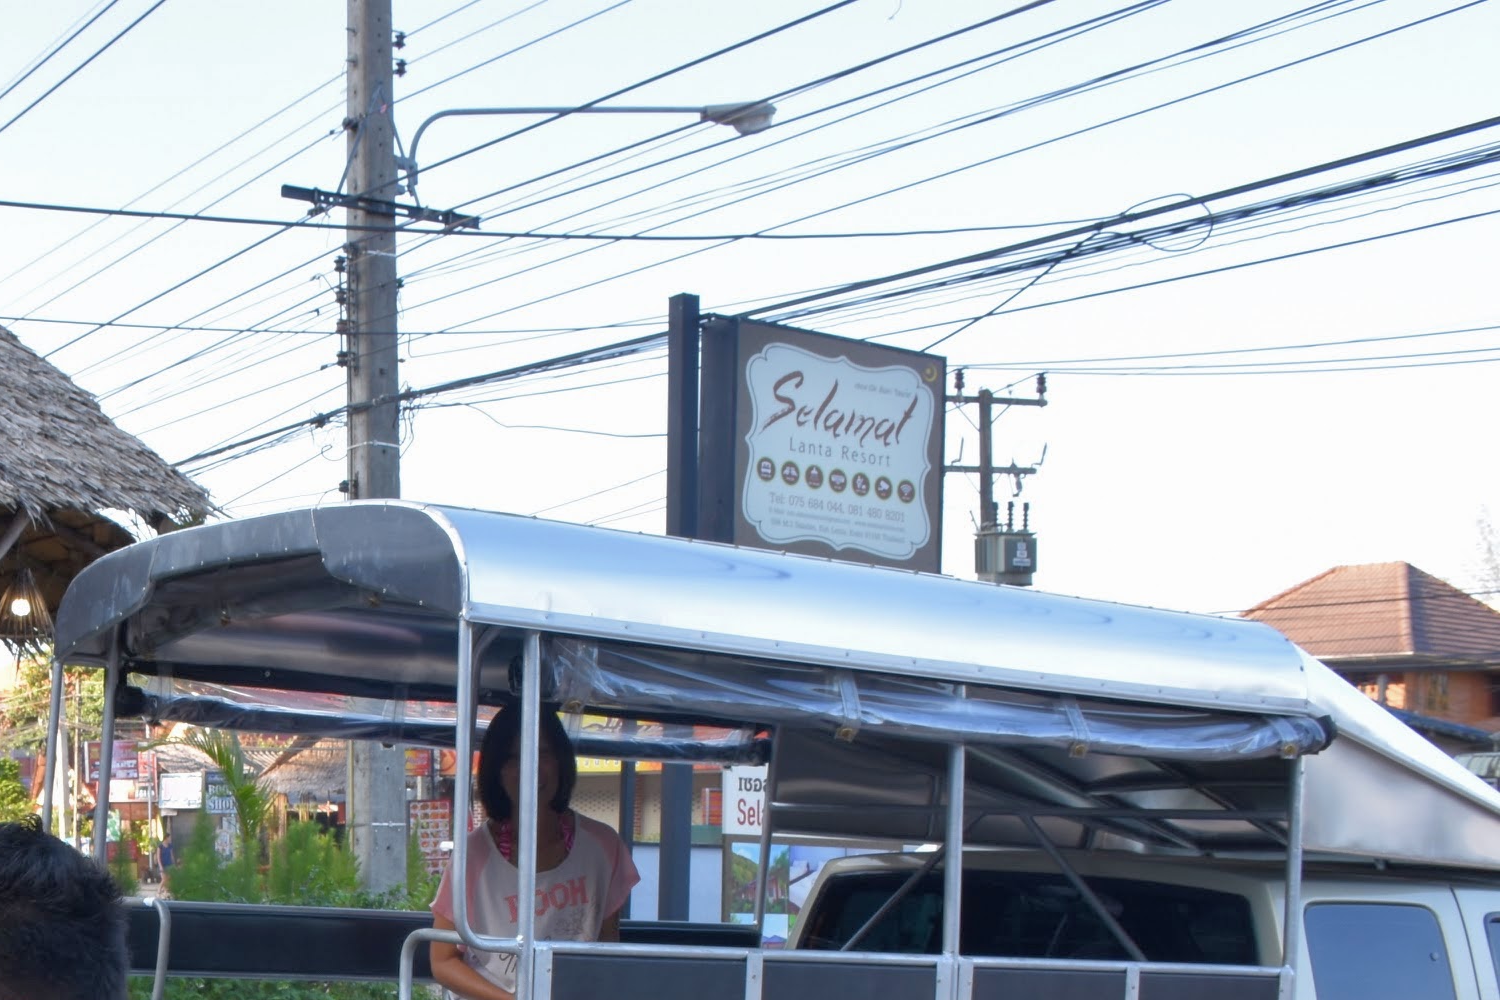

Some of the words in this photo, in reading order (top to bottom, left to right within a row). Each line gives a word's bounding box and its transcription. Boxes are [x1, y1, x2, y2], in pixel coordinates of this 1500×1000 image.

[789, 436, 832, 458] Lanta
[841, 445, 891, 467] Resort
[788, 494, 805, 508] 075
[847, 503, 863, 517] 081
[866, 506, 883, 519] 480
[208, 784, 232, 795] BOO
[737, 798, 764, 826] Sel
